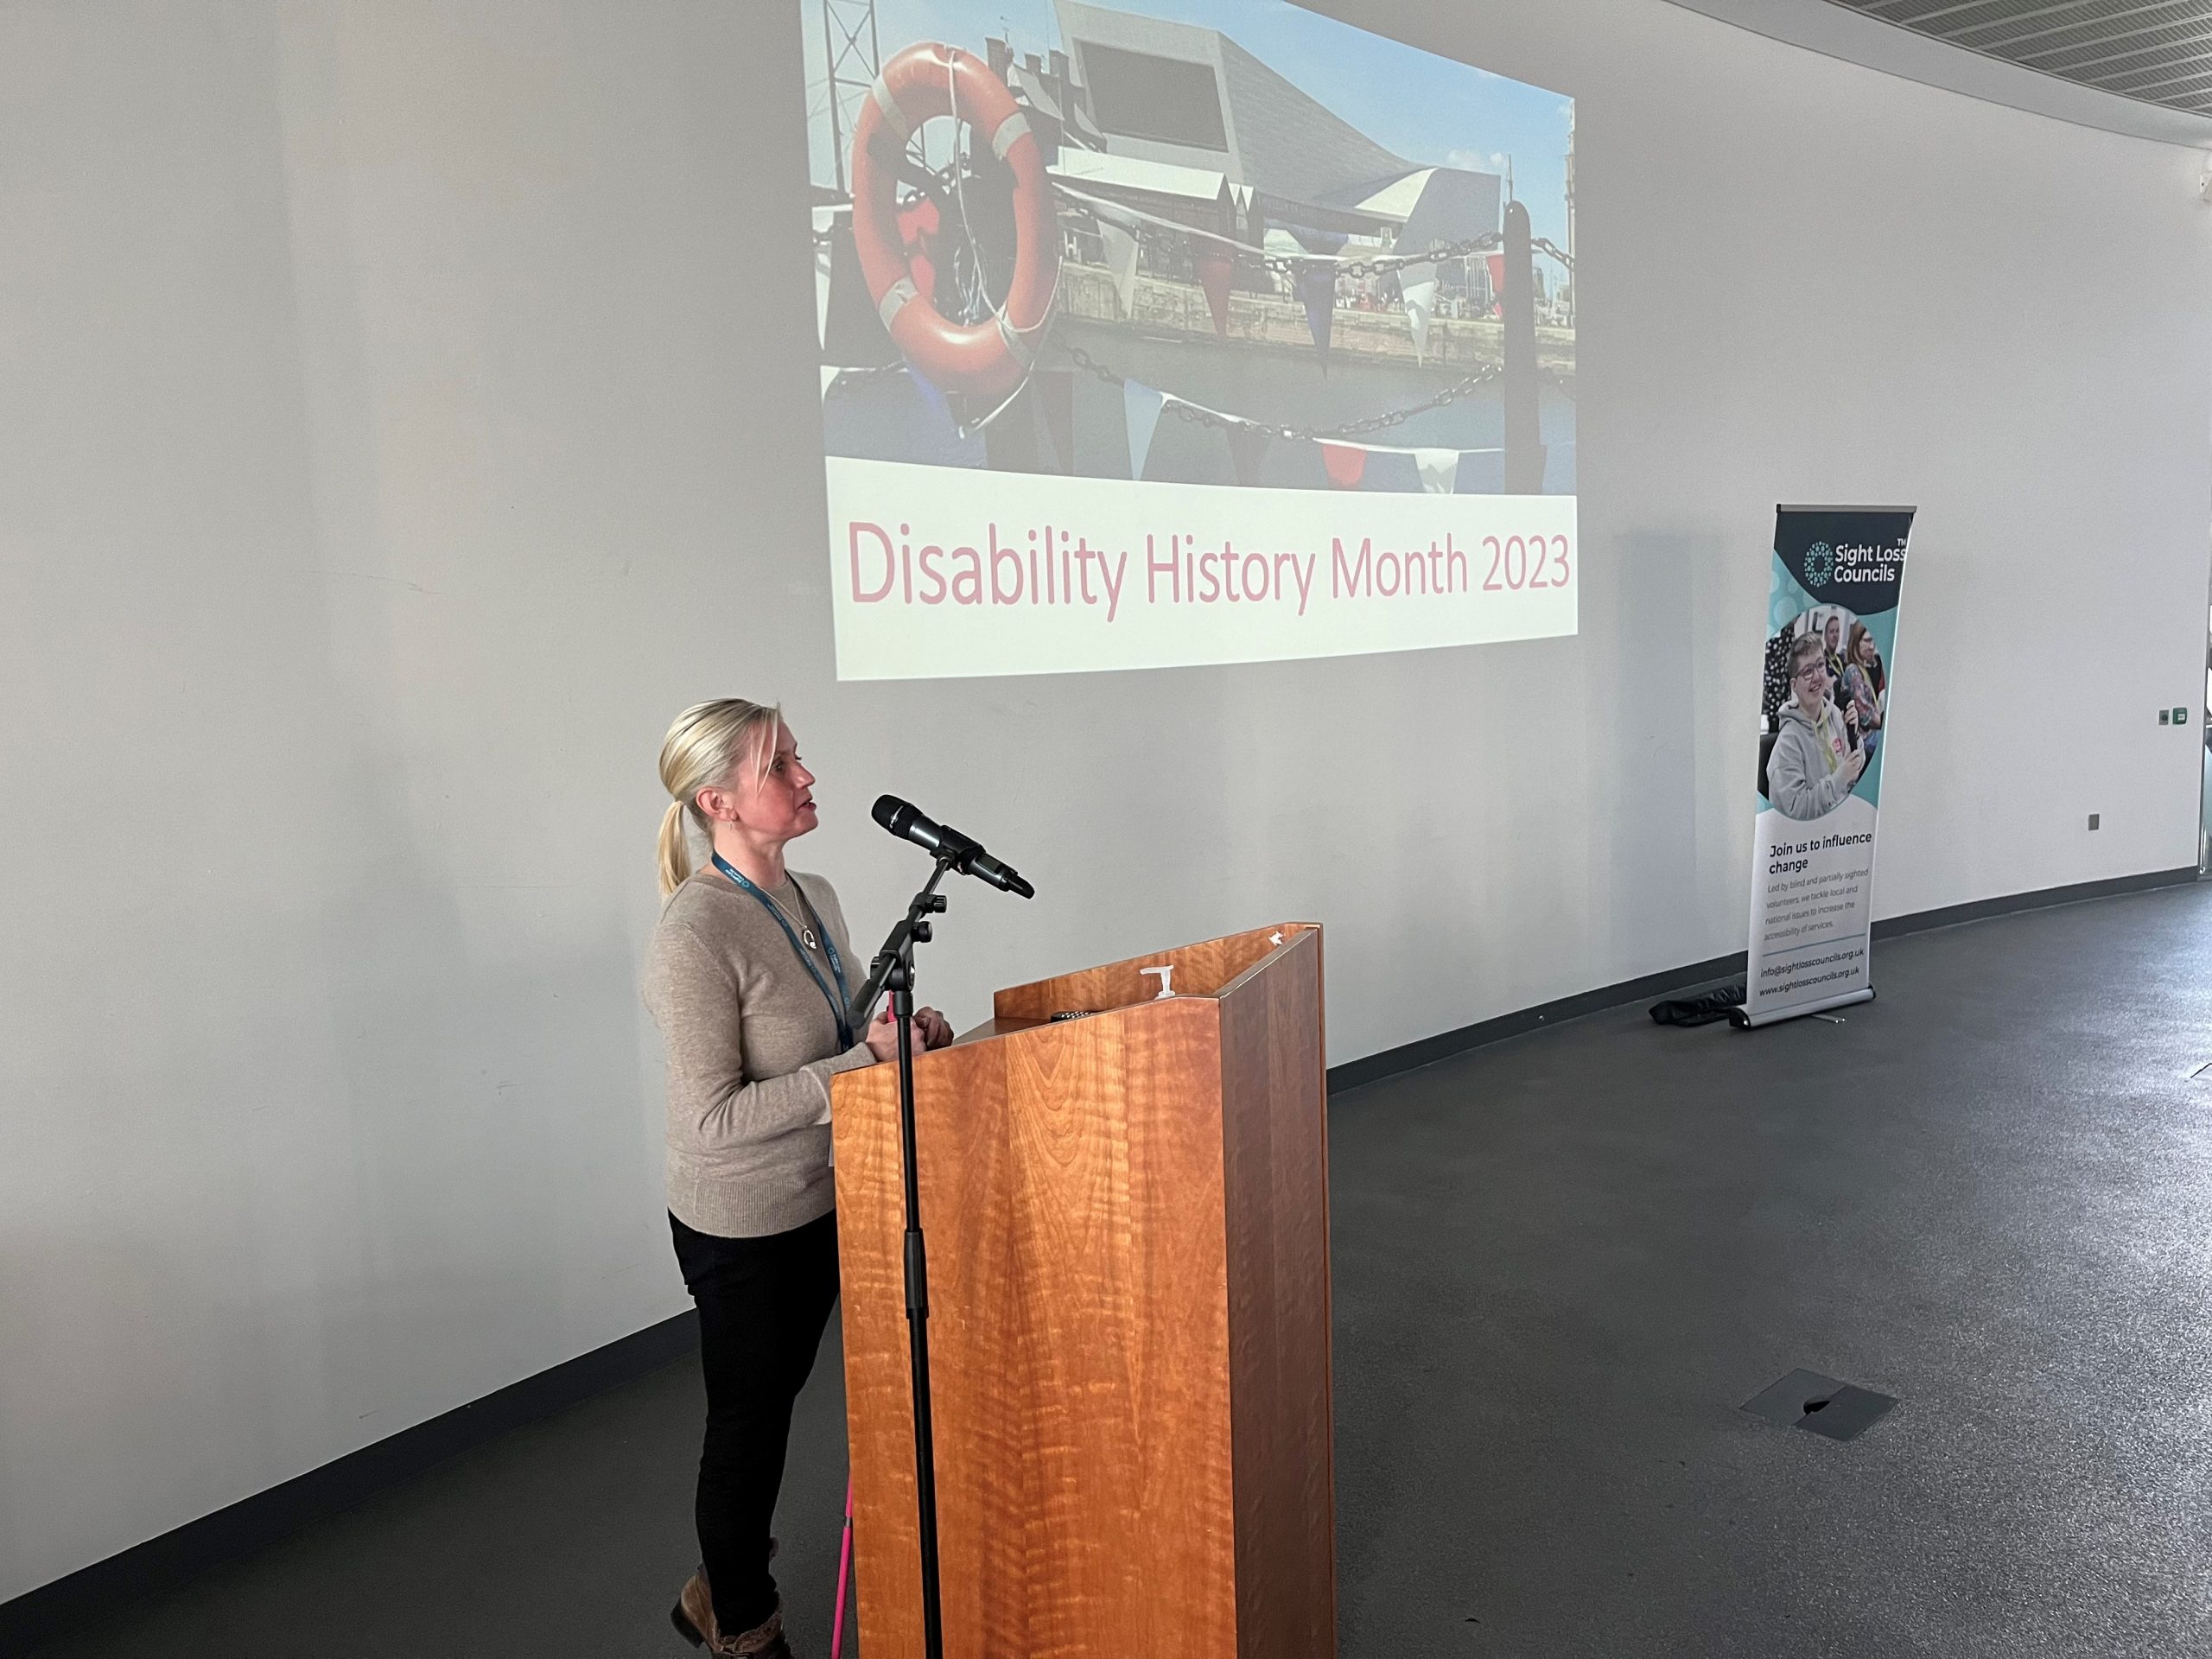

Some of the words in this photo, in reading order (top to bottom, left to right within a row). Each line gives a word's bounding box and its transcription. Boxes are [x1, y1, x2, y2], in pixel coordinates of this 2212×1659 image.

[1835, 543, 1873, 567] Sight
[1876, 544, 1906, 563] Loss
[849, 520, 1128, 622] Disability
[1146, 533, 1316, 616] History
[1332, 531, 1468, 600] Month
[1483, 534, 1570, 591] 2023
[1834, 563, 1895, 582] Councils
[1770, 842, 1793, 857] Join
[1796, 842, 1808, 854] us
[1810, 840, 1821, 851] to
[1822, 833, 1872, 849] influence
[1769, 859, 1808, 874] change
[1768, 881, 1780, 893] Led
[1781, 881, 1789, 892] by
[1789, 879, 1805, 889] blind
[1806, 875, 1818, 886] and
[1818, 872, 1844, 884] partially
[1844, 868, 1869, 880] sighted
[1801, 894, 1810, 903] we
[1829, 887, 1845, 898] local
[1846, 885, 1858, 894] and
[1765, 912, 1791, 925] national
[1810, 907, 1817, 916] to
[1817, 902, 1844, 914] increase
[1844, 900, 1855, 910] the
[1801, 924, 1808, 934] of
[1760, 947, 1864, 978] info@sightlosscouncils.org.uk
[1759, 965, 1859, 996] www.sightlosscouncils.org.uk
